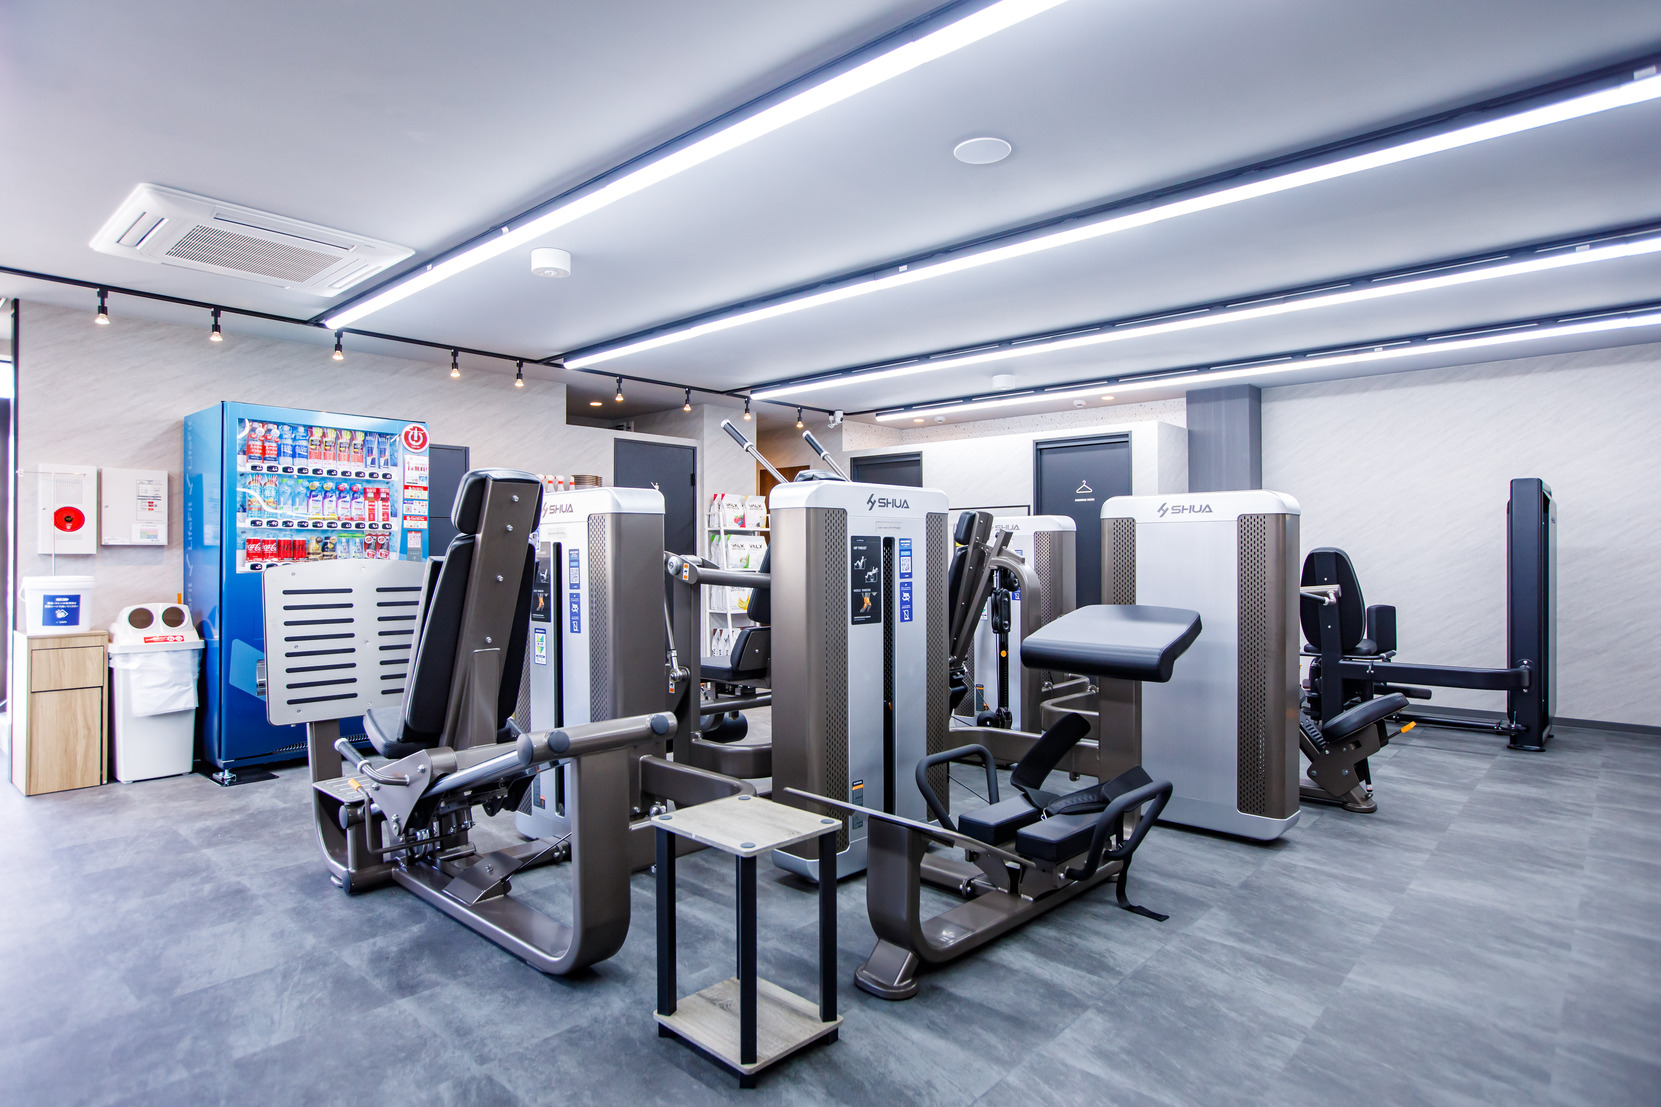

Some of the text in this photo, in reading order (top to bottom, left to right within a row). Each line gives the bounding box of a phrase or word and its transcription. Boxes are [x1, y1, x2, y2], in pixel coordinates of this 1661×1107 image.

[878, 498, 910, 509] SHUA
[549, 504, 574, 514] SHUA
[1170, 504, 1213, 514] SHUA
